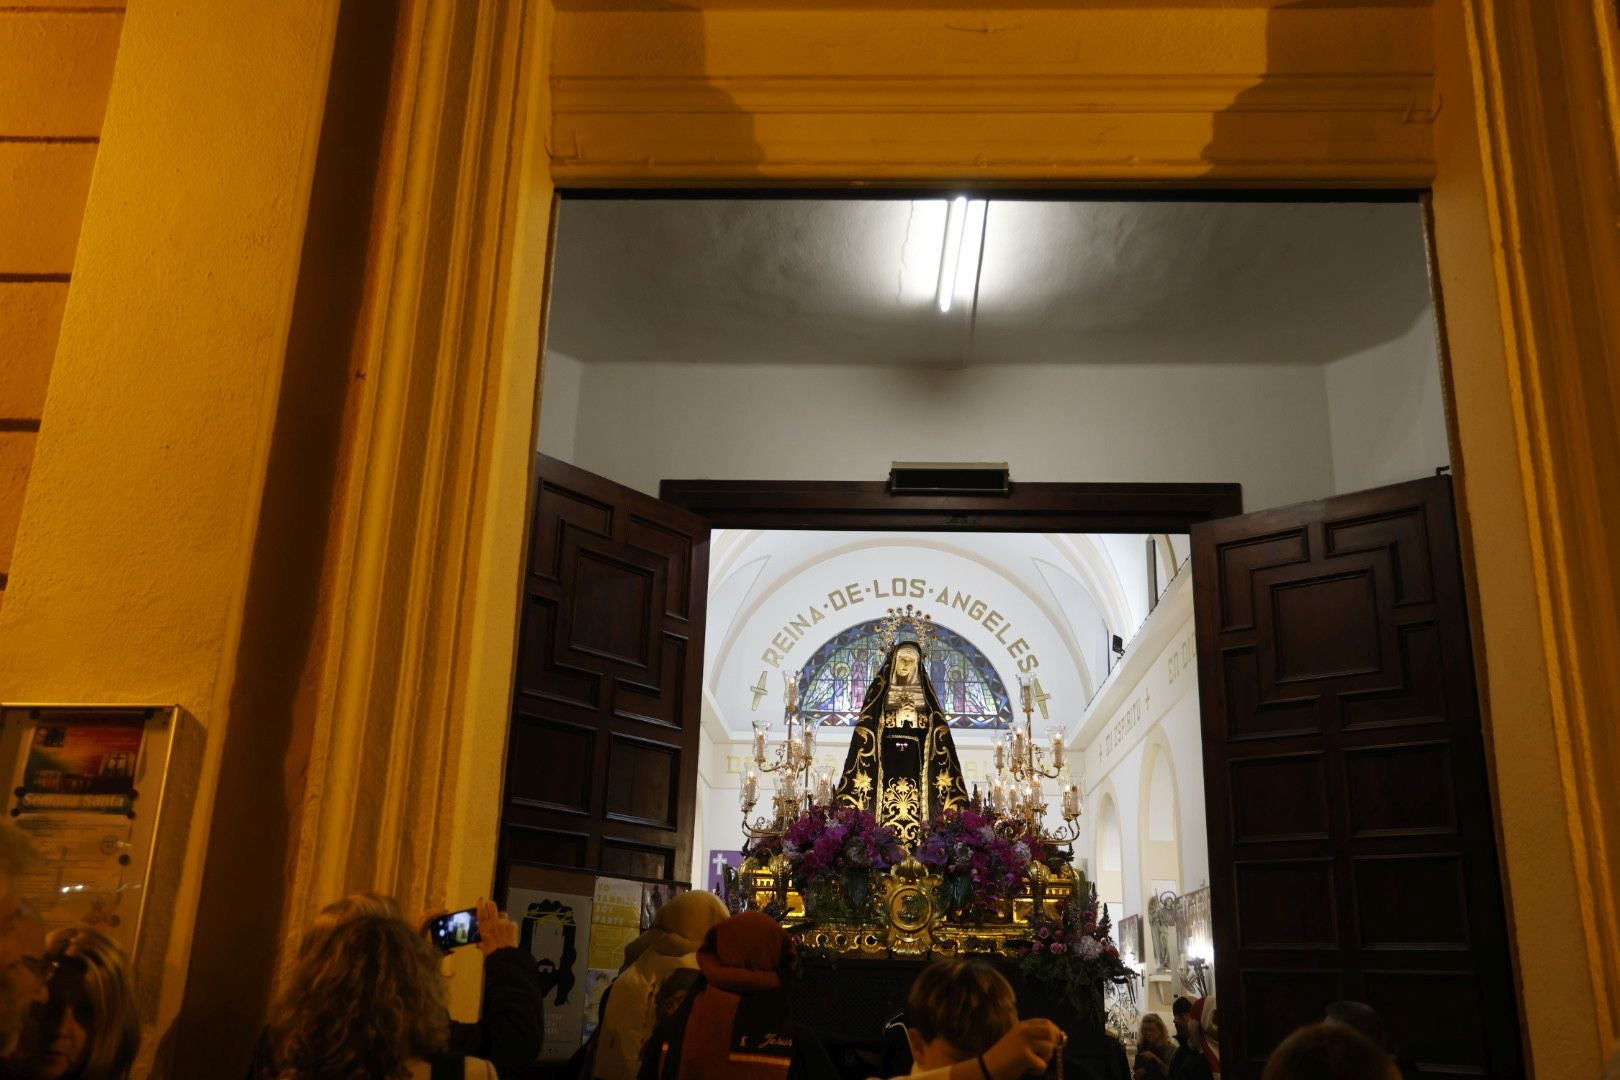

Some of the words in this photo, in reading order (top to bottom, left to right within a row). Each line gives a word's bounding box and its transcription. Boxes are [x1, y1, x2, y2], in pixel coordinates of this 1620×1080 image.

[761, 605, 826, 668] REINA
[827, 582, 865, 612] DE
[873, 577, 927, 598] LOS
[934, 585, 1040, 673] ANGELES
